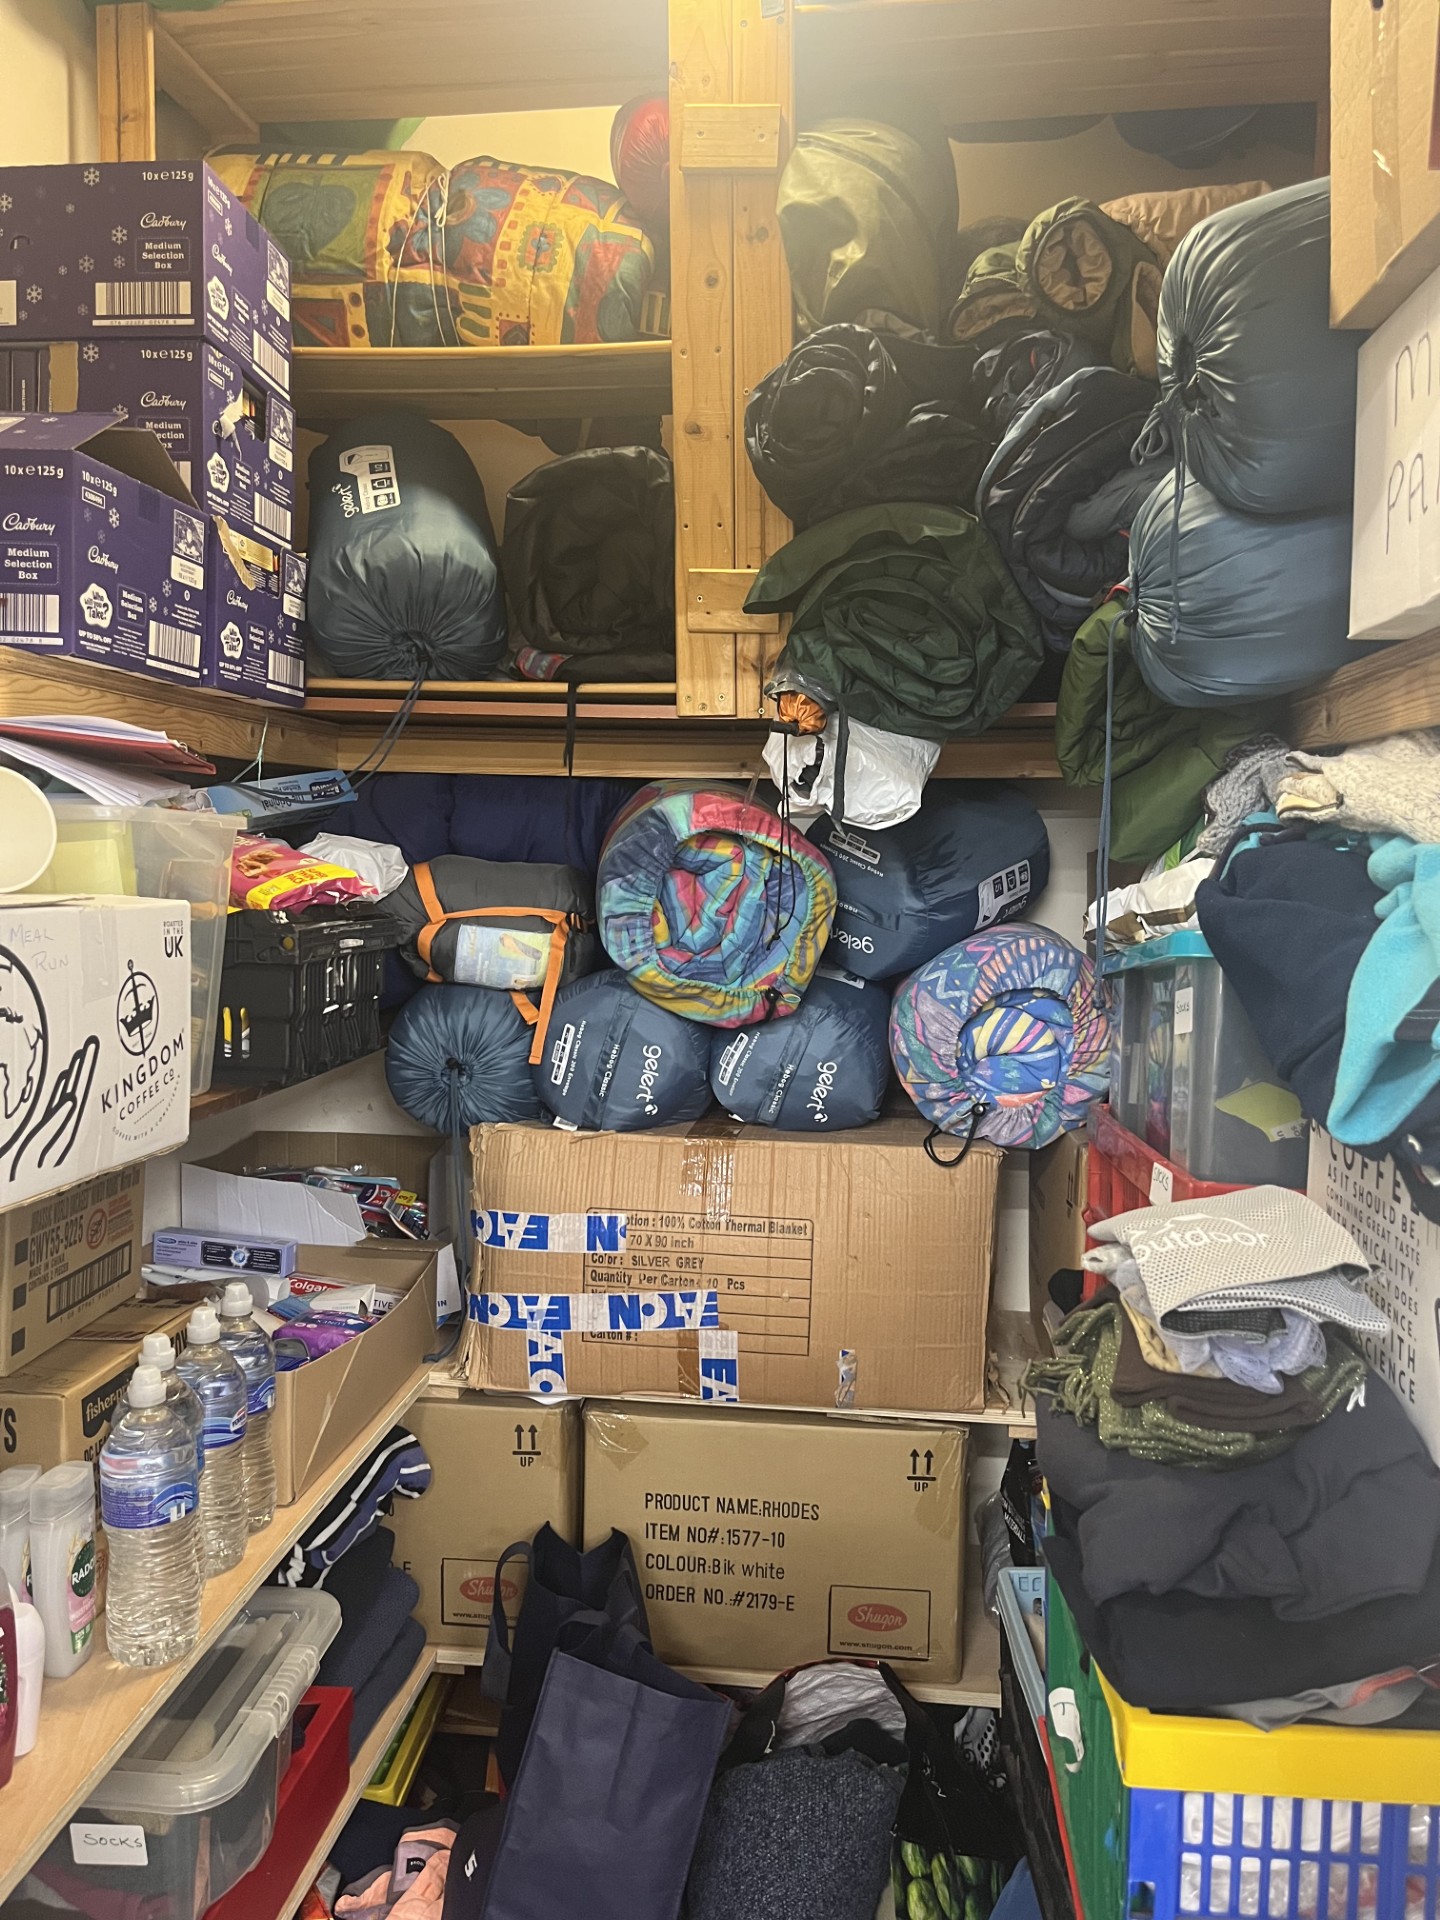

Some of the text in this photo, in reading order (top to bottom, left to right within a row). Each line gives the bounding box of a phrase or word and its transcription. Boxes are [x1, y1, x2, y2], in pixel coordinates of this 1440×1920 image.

[140, 212, 187, 230] Cadbury
[142, 251, 185, 260] Selection
[145, 242, 182, 250] Medium
[154, 261, 173, 269] Box
[140, 391, 187, 409] Cadbury
[145, 421, 182, 430] Medium
[156, 431, 185, 440] ection
[162, 441, 173, 449] ox
[338, 484, 360, 518] gelert
[2, 512, 56, 535] Cadbury
[7, 547, 50, 558] Medium
[87, 545, 119, 575] Cadbury
[4, 559, 53, 569] Selection
[18, 570, 39, 580] Box
[226, 589, 249, 613] Cadbury
[9, 923, 55, 945] MEAL
[164, 935, 184, 958] UK
[32, 950, 71, 972] RUN
[101, 1032, 184, 1114] KINGDOM
[598, 1043, 620, 1098] Hebog Classic
[636, 1044, 662, 1103] gelert
[768, 1063, 795, 1114] Hebog Classic
[806, 1061, 838, 1112] gelert
[119, 1080, 160, 1121] COFFEE
[1330, 1137, 1420, 1216] COFFE
[1327, 1163, 1337, 1183] AS
[1340, 1172, 1349, 1192] IT
[1353, 1181, 1396, 1225] SHOULD
[470, 1209, 550, 1250] EATO
[659, 1215, 685, 1230] 100%
[688, 1218, 721, 1231] Cotton
[725, 1219, 766, 1233] Thermal
[768, 1221, 808, 1236] Blanket
[1326, 1185, 1420, 1266] COMBINING GREAT TASTE
[29, 1215, 84, 1267] GWY55-9225
[629, 1234, 694, 1249] 70 X 90 inch
[1133, 1227, 1269, 1264] outdoor
[631, 1255, 671, 1268] SILVER
[676, 1256, 705, 1269] GREY
[290, 1278, 332, 1294] Colgat
[590, 1269, 633, 1286] Quantity
[638, 1273, 657, 1285] Per
[727, 1278, 745, 1290] Pcs
[608, 1291, 719, 1331] EATON
[1394, 1285, 1418, 1316] DOES
[590, 1331, 623, 1341] Carton
[1382, 1328, 1416, 1373] ITH
[520, 1456, 534, 1467] UP
[914, 1482, 929, 1492] UP
[645, 1492, 820, 1521] PRODUCT NAME:RHODES
[645, 1522, 680, 1542] ITEM
[742, 1562, 785, 1580] white
[467, 1580, 514, 1598] Shuon
[645, 1583, 695, 1603] ORDER
[855, 1605, 902, 1629] Shugon
[839, 1640, 913, 1652] www.shugon.com
